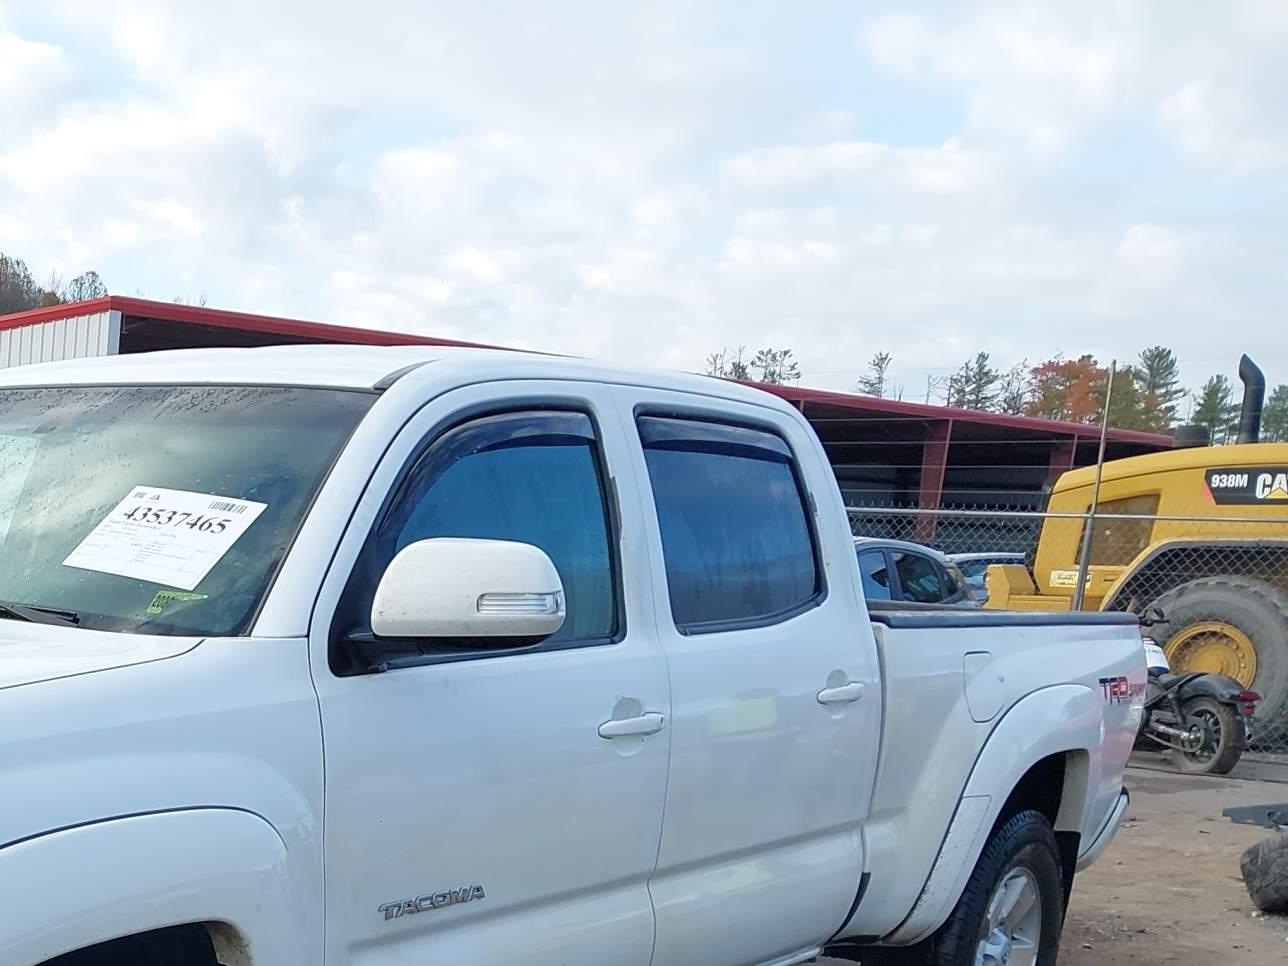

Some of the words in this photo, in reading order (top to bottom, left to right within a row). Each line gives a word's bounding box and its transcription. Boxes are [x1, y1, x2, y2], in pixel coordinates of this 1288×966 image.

[1211, 474, 1249, 488] 938M
[1255, 473, 1288, 499] CA
[123, 505, 233, 534] 43537465
[377, 884, 486, 921] TACOMA
